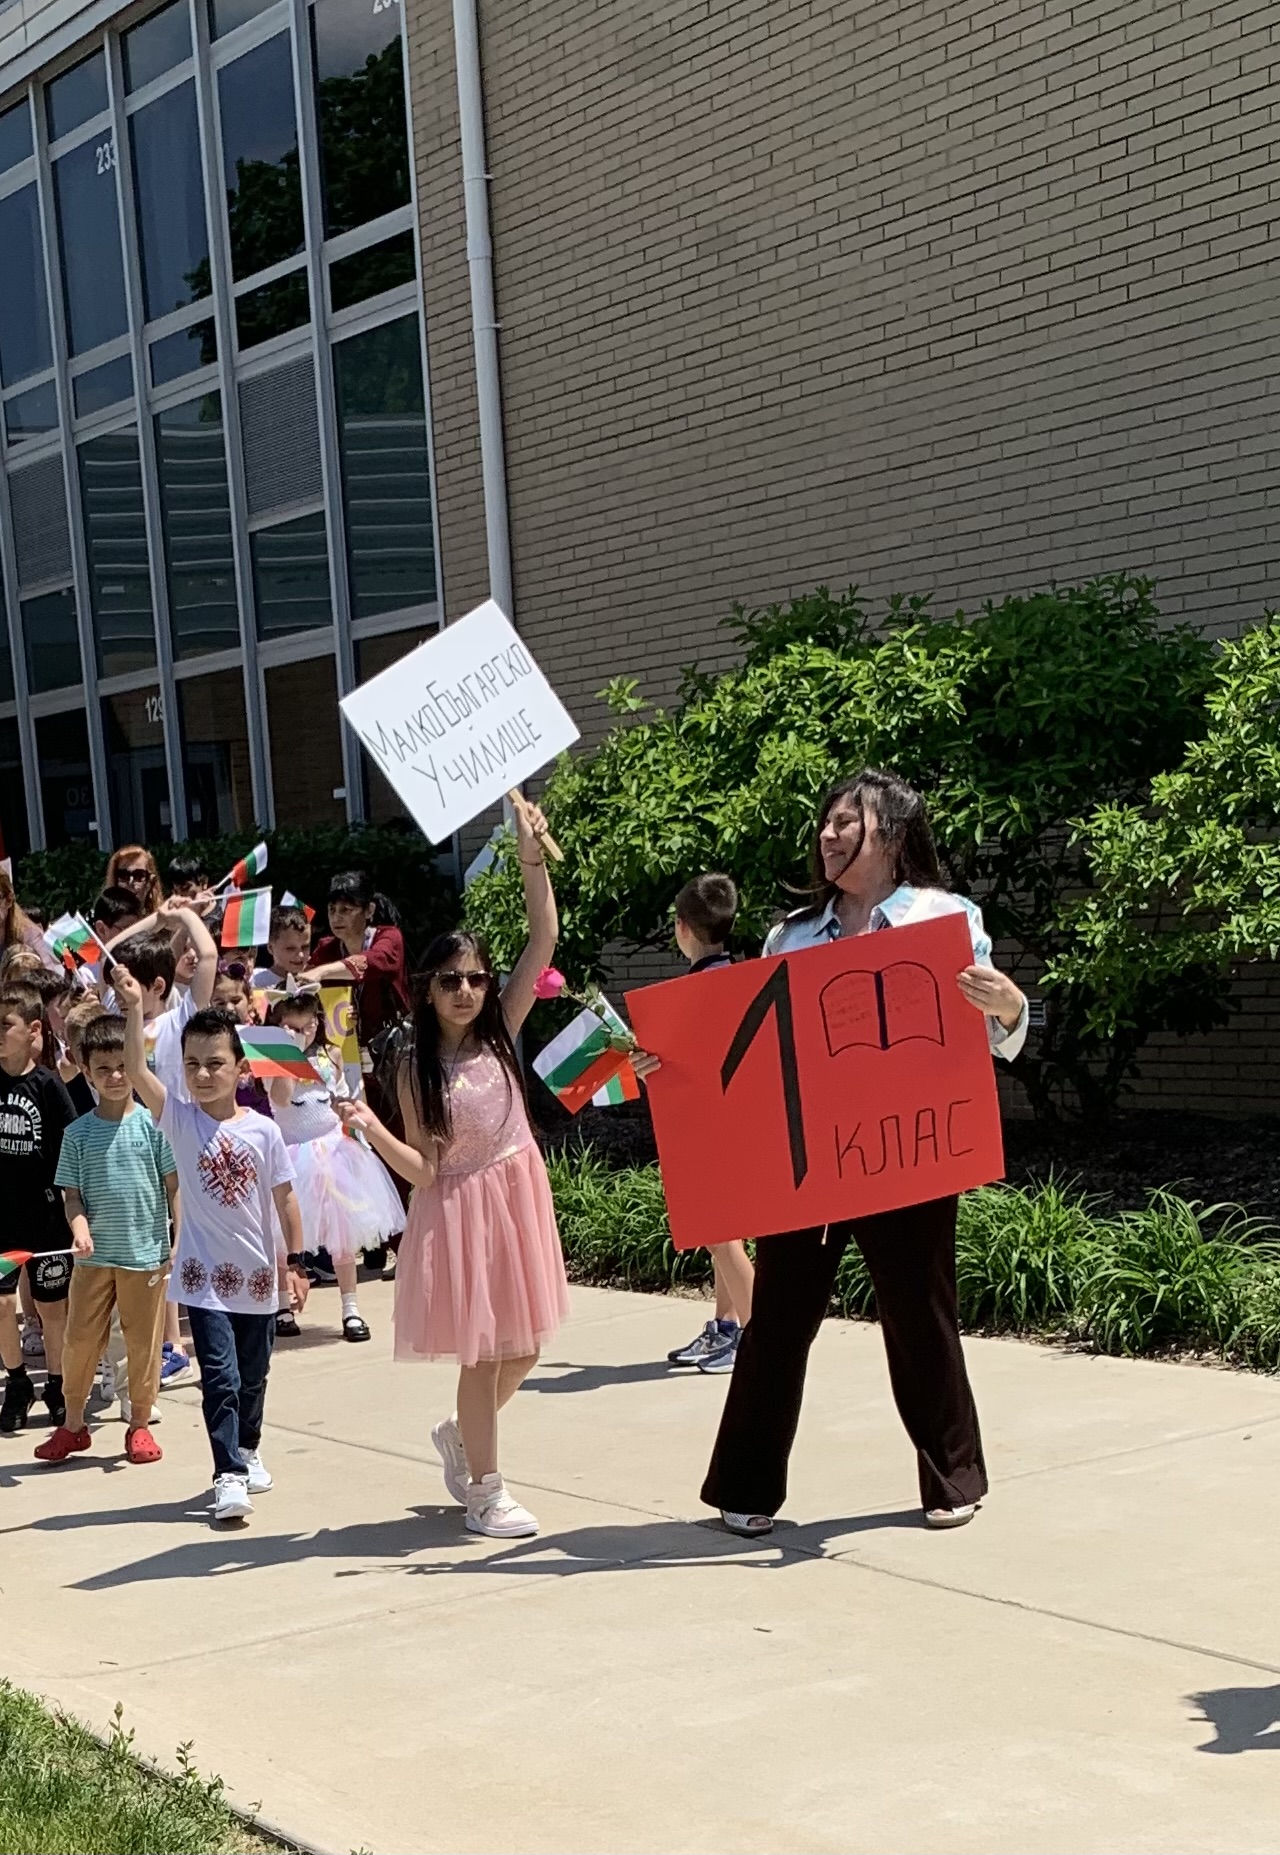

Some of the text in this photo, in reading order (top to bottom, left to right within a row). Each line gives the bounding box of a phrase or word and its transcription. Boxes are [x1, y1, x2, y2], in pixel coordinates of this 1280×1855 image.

[411, 708, 543, 809] УЧИЛИЩЕ
[720, 958, 808, 1191] 1
[4, 1113, 26, 1135] NBA
[7, 1092, 42, 1141] BASKETBALL
[835, 1098, 974, 1179] КЛАС
